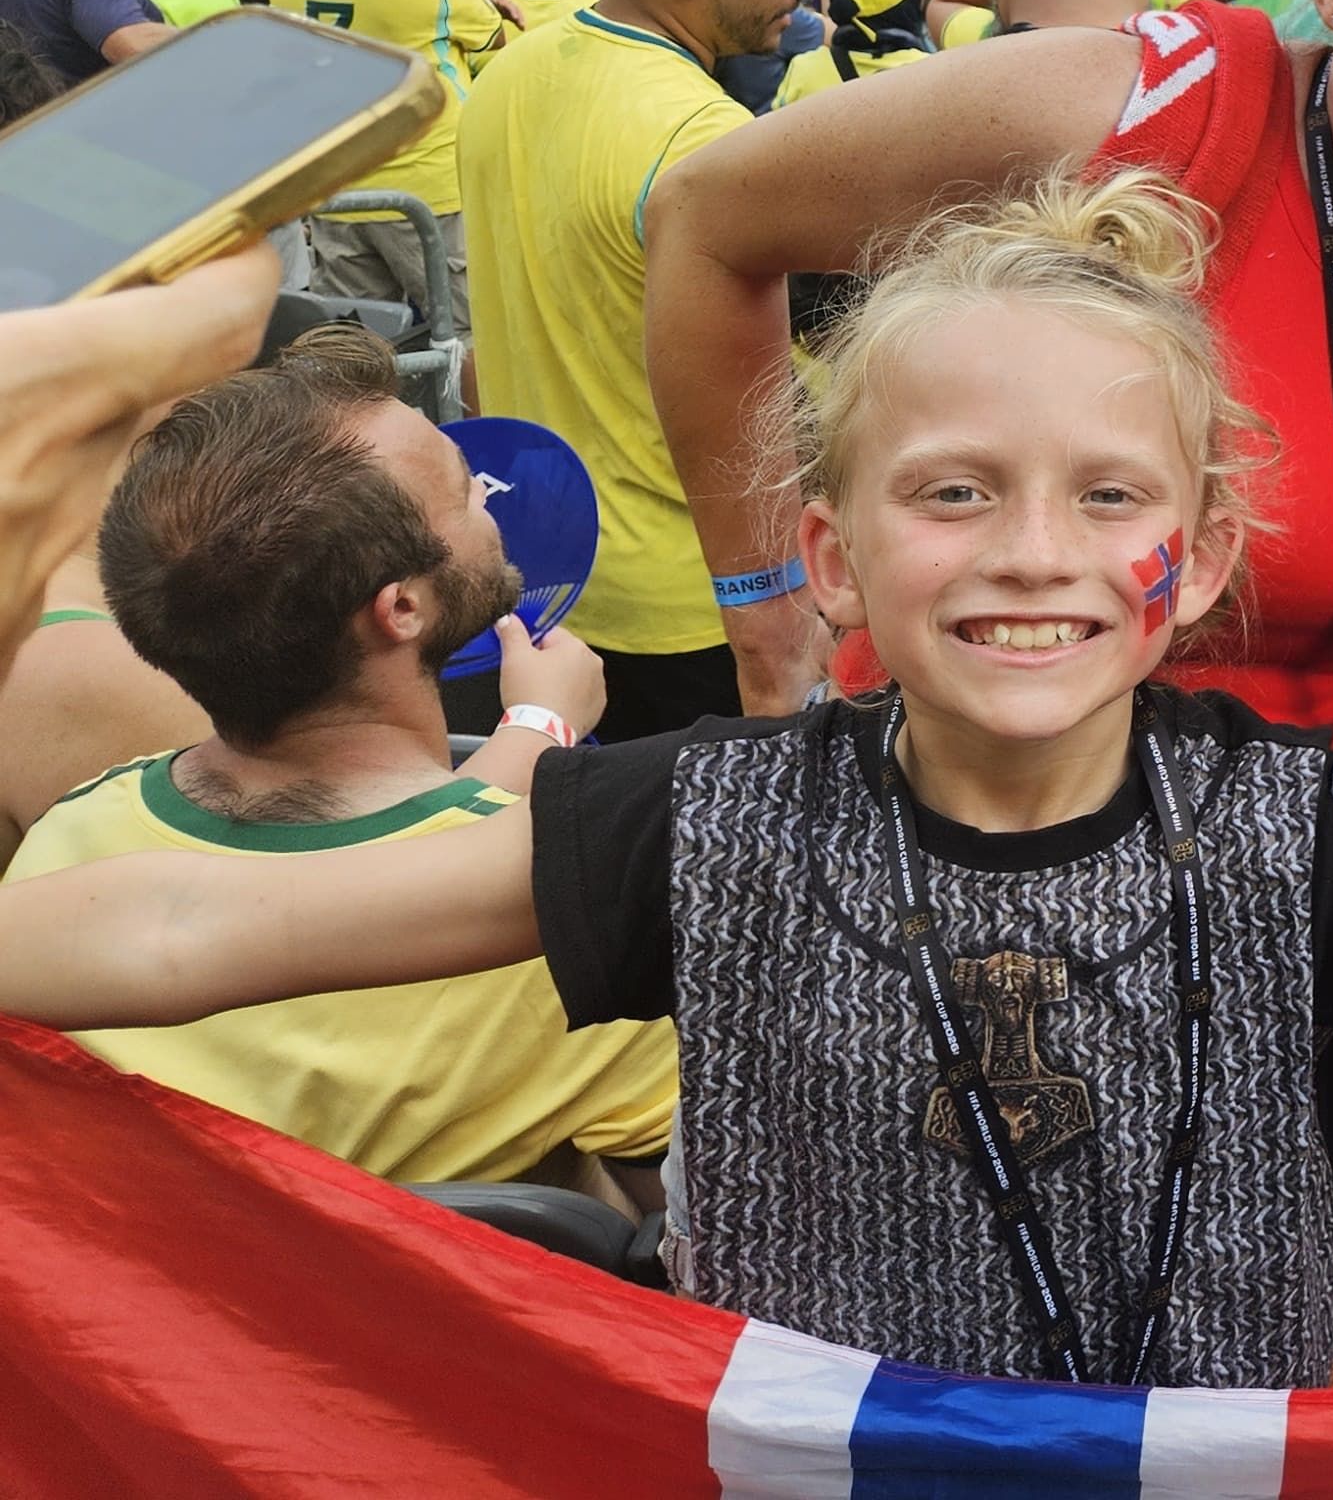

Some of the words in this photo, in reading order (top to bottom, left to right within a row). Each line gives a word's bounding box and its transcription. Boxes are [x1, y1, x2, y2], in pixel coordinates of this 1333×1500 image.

[713, 571, 782, 596] RANSIT
[1162, 782, 1178, 814] WORLD
[1191, 926, 1200, 960] WORLD
[925, 967, 942, 1002] WORLD
[973, 1112, 992, 1146] WORLD
[1024, 1242, 1042, 1274] WORLD
